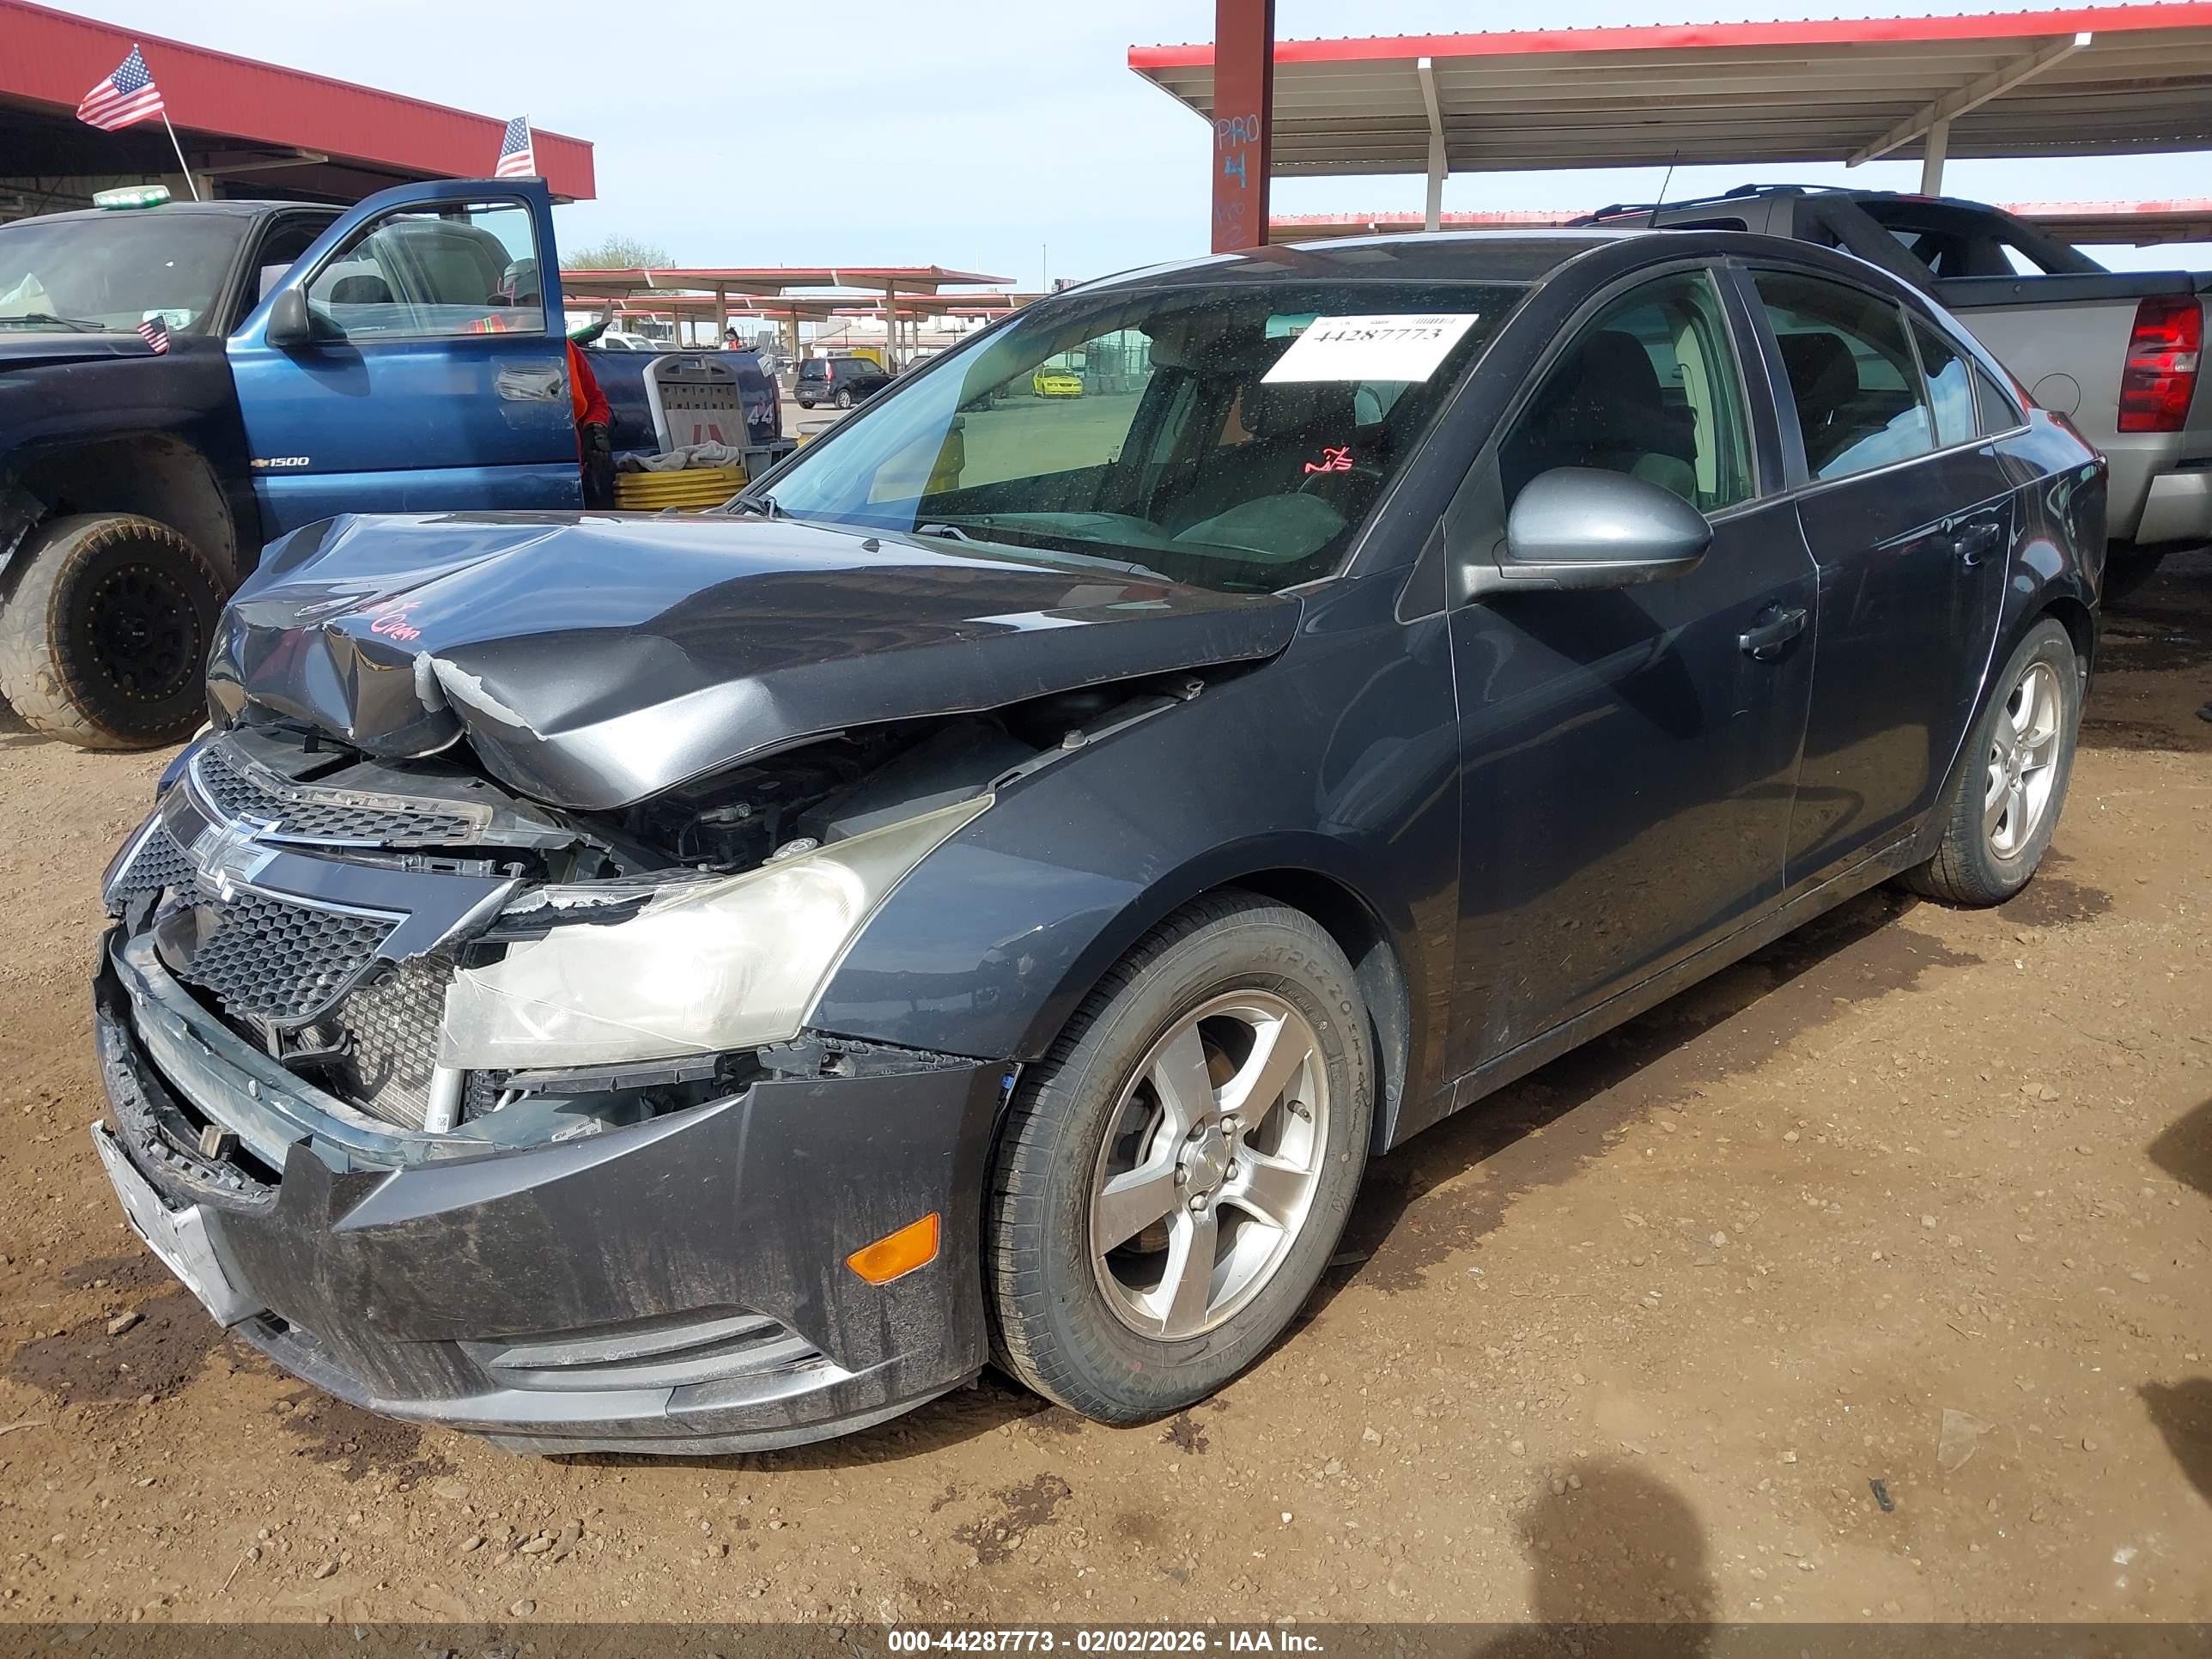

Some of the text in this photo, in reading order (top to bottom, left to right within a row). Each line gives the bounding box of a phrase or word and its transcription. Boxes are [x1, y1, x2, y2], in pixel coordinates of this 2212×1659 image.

[1214, 114, 1260, 150] PRO
[1224, 151, 1246, 188] 4
[1313, 328, 1443, 343] 44287773
[747, 404, 773, 425] 44
[270, 457, 310, 467] 1500
